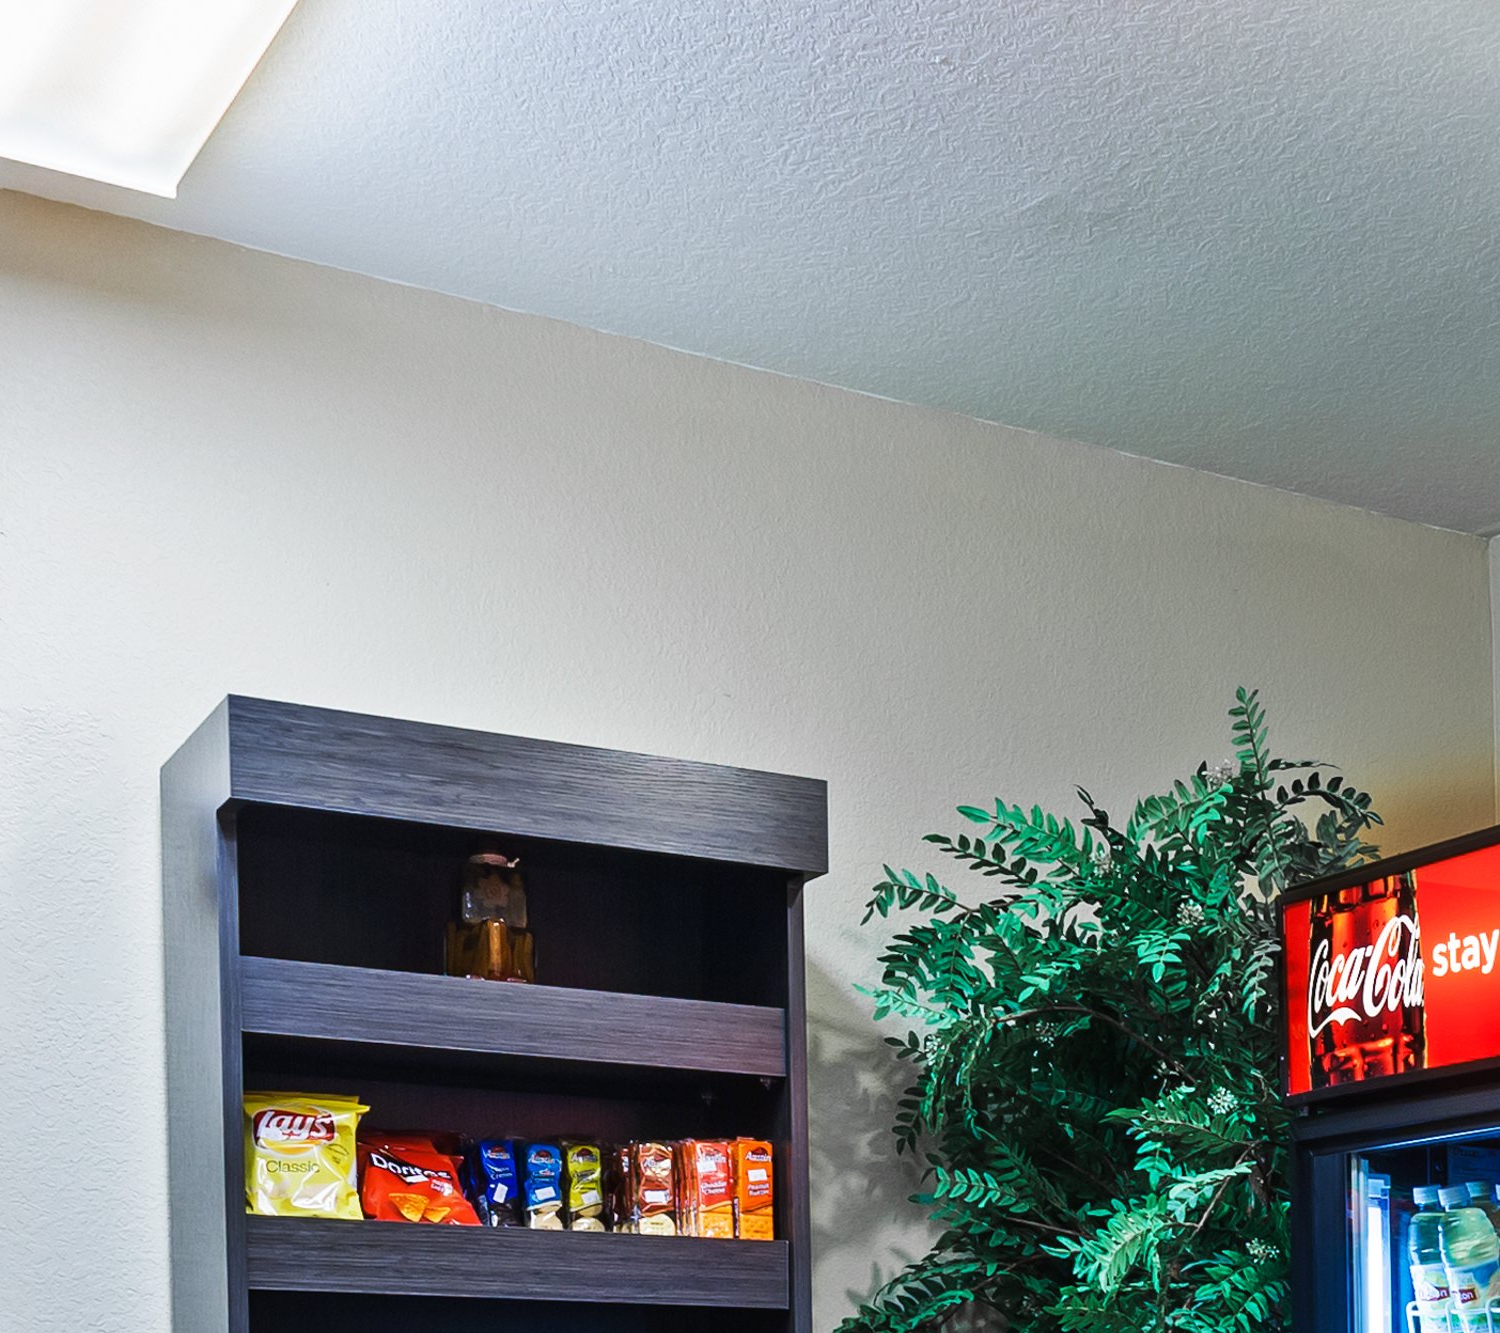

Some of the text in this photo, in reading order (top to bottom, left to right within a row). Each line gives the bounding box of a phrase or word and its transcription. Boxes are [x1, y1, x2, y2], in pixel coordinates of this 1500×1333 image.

[1431, 921, 1499, 979] stay
[257, 1109, 335, 1140] Lay's
[266, 1159, 320, 1174] Classic
